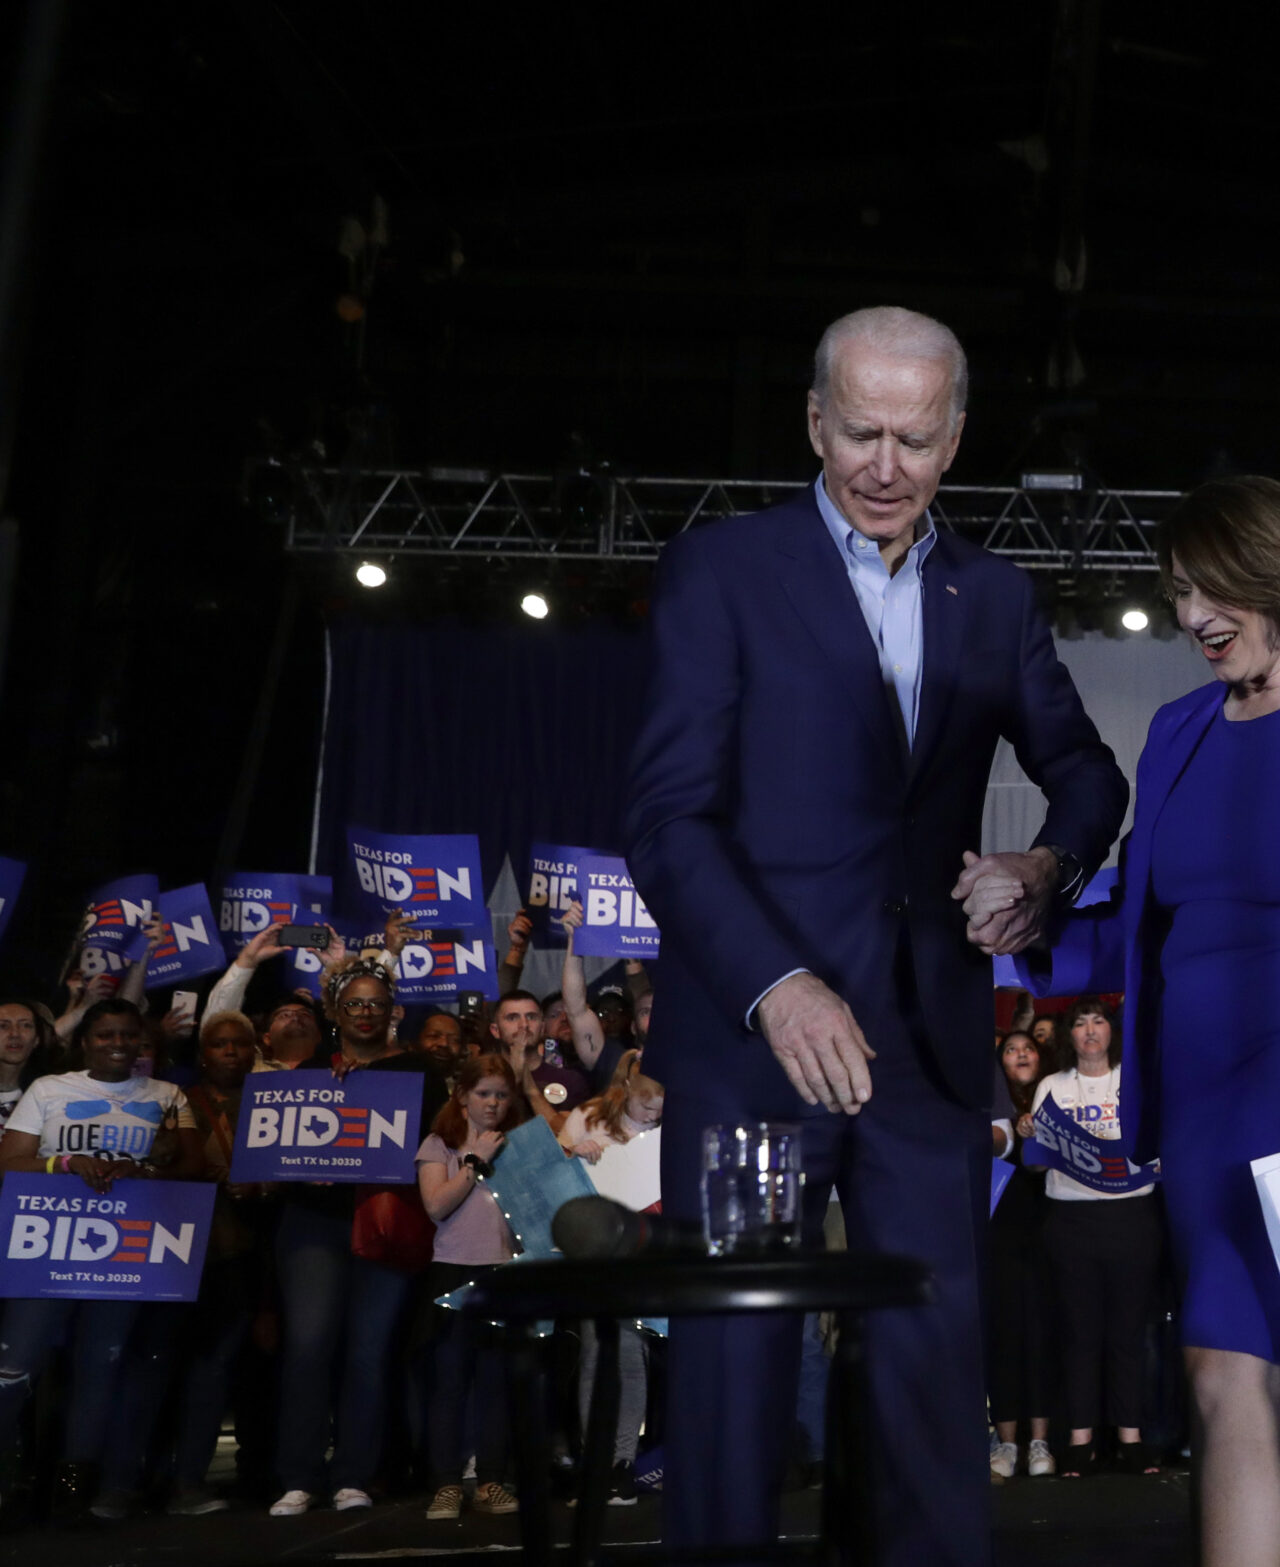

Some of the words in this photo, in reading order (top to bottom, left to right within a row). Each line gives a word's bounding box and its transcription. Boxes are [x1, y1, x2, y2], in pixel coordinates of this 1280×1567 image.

[353, 843, 383, 862] TEXAS
[385, 852, 413, 865] FOR
[534, 859, 564, 874] TEXAS
[355, 857, 472, 902] BIDEN
[247, 889, 272, 899] FOR
[529, 872, 577, 909] BID
[364, 932, 385, 946] TEX
[641, 937, 652, 945] TX
[360, 940, 487, 980] DEN
[254, 1090, 305, 1104] TEXAS
[309, 1089, 345, 1103] FOR
[1063, 1103, 1119, 1122] IDE
[247, 1106, 407, 1149] BIDEN
[1074, 1136, 1101, 1156] FOR
[280, 1156, 301, 1165] Text
[303, 1156, 317, 1165] TX
[319, 1157, 330, 1166] to
[331, 1158, 362, 1167] 30330
[17, 1195, 82, 1213] TEXAS
[86, 1199, 127, 1215] FOR
[7, 1214, 195, 1265] BIDEN
[50, 1271, 73, 1281] Text
[75, 1272, 91, 1282] TX
[92, 1273, 105, 1282] to
[107, 1274, 141, 1283] 30330
